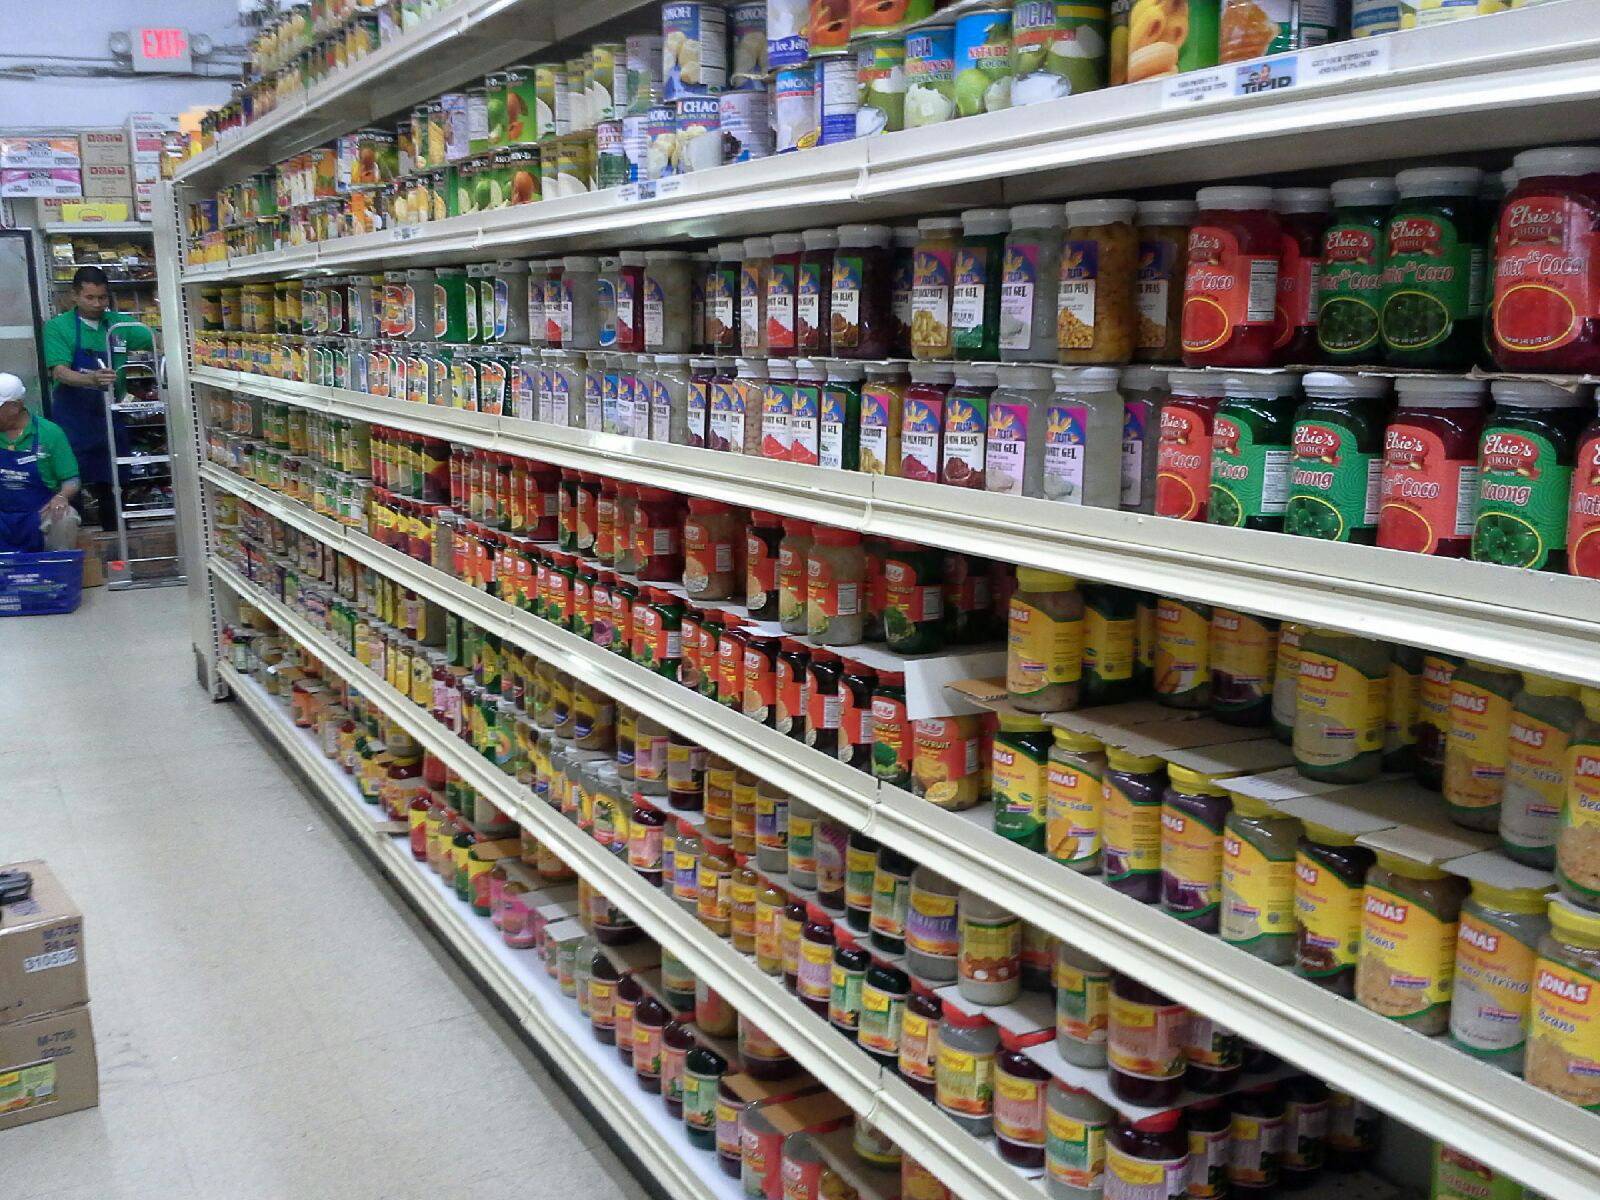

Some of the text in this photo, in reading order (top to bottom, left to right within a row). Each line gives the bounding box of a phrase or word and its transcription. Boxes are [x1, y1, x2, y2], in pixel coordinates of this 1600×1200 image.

[142, 28, 182, 59] EXIT
[1509, 205, 1563, 228] Elsie's
[1327, 231, 1369, 250] Elsie's
[1391, 220, 1437, 240] Elsie's
[1415, 265, 1455, 282] Coco
[1539, 253, 1586, 275] Coco
[1201, 272, 1234, 291] Coco
[1294, 425, 1335, 447] Elsie's
[1385, 431, 1424, 452] Elsie's
[1483, 433, 1533, 457] Elsie's
[1003, 442, 1018, 455] GEL
[1061, 447, 1077, 460] GEL
[1171, 452, 1201, 469] Coco
[1487, 455, 1523, 467] CHOICE
[1401, 478, 1441, 499] Coco
[1480, 478, 1532, 507] Kaong
[1539, 970, 1590, 1003] JONAS
